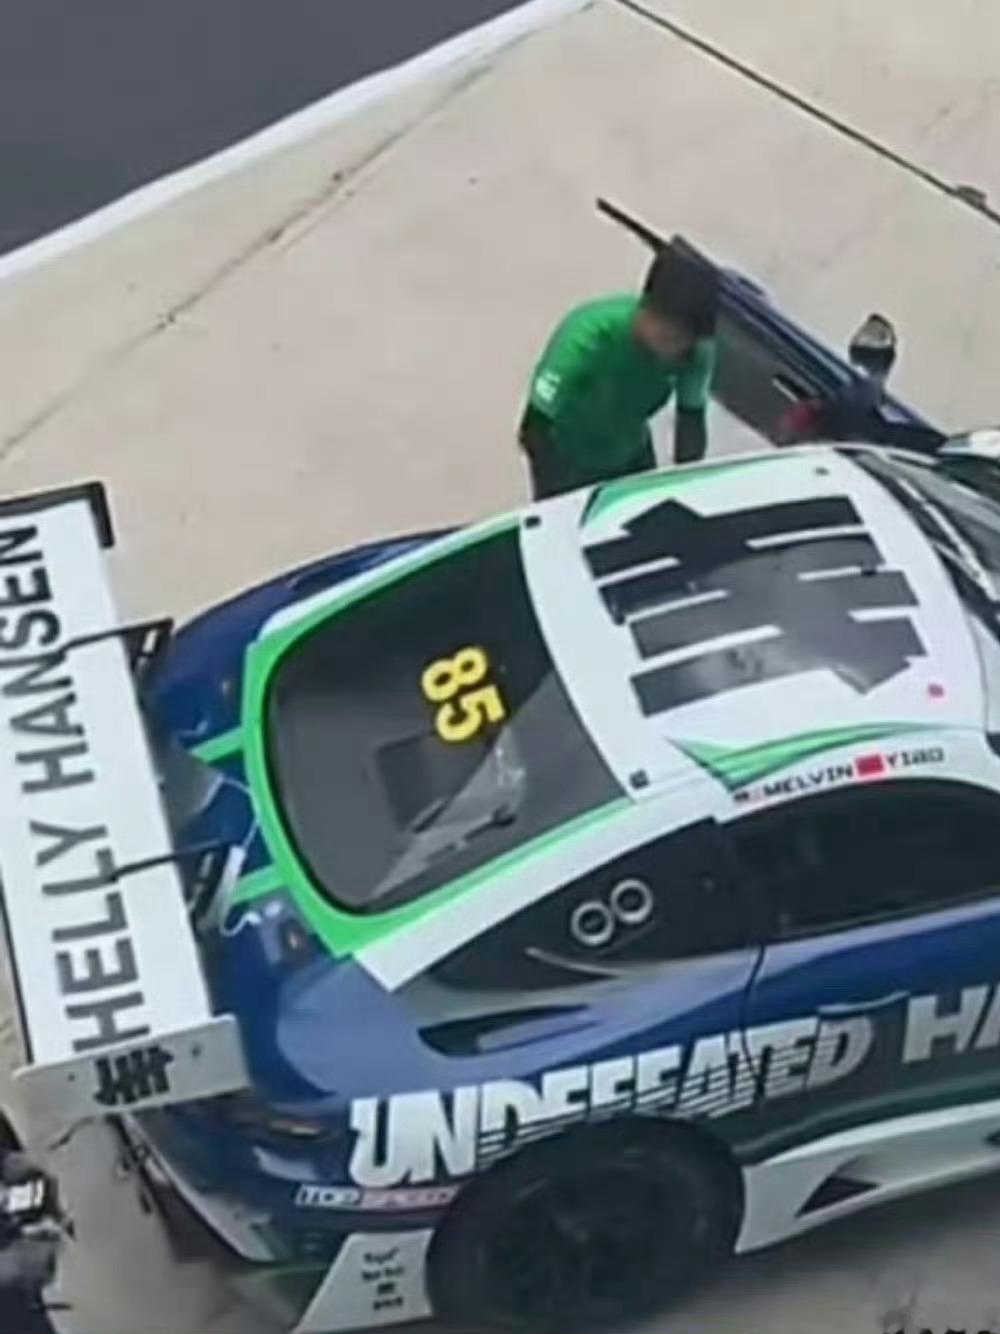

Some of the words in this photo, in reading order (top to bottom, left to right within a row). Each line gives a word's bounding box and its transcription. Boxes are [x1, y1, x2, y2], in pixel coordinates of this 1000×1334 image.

[420, 646, 505, 743] 85
[763, 764, 854, 797] MELVIN
[30, 820, 151, 1051] HELLY
[348, 1015, 873, 1188] UNDEFEATED
